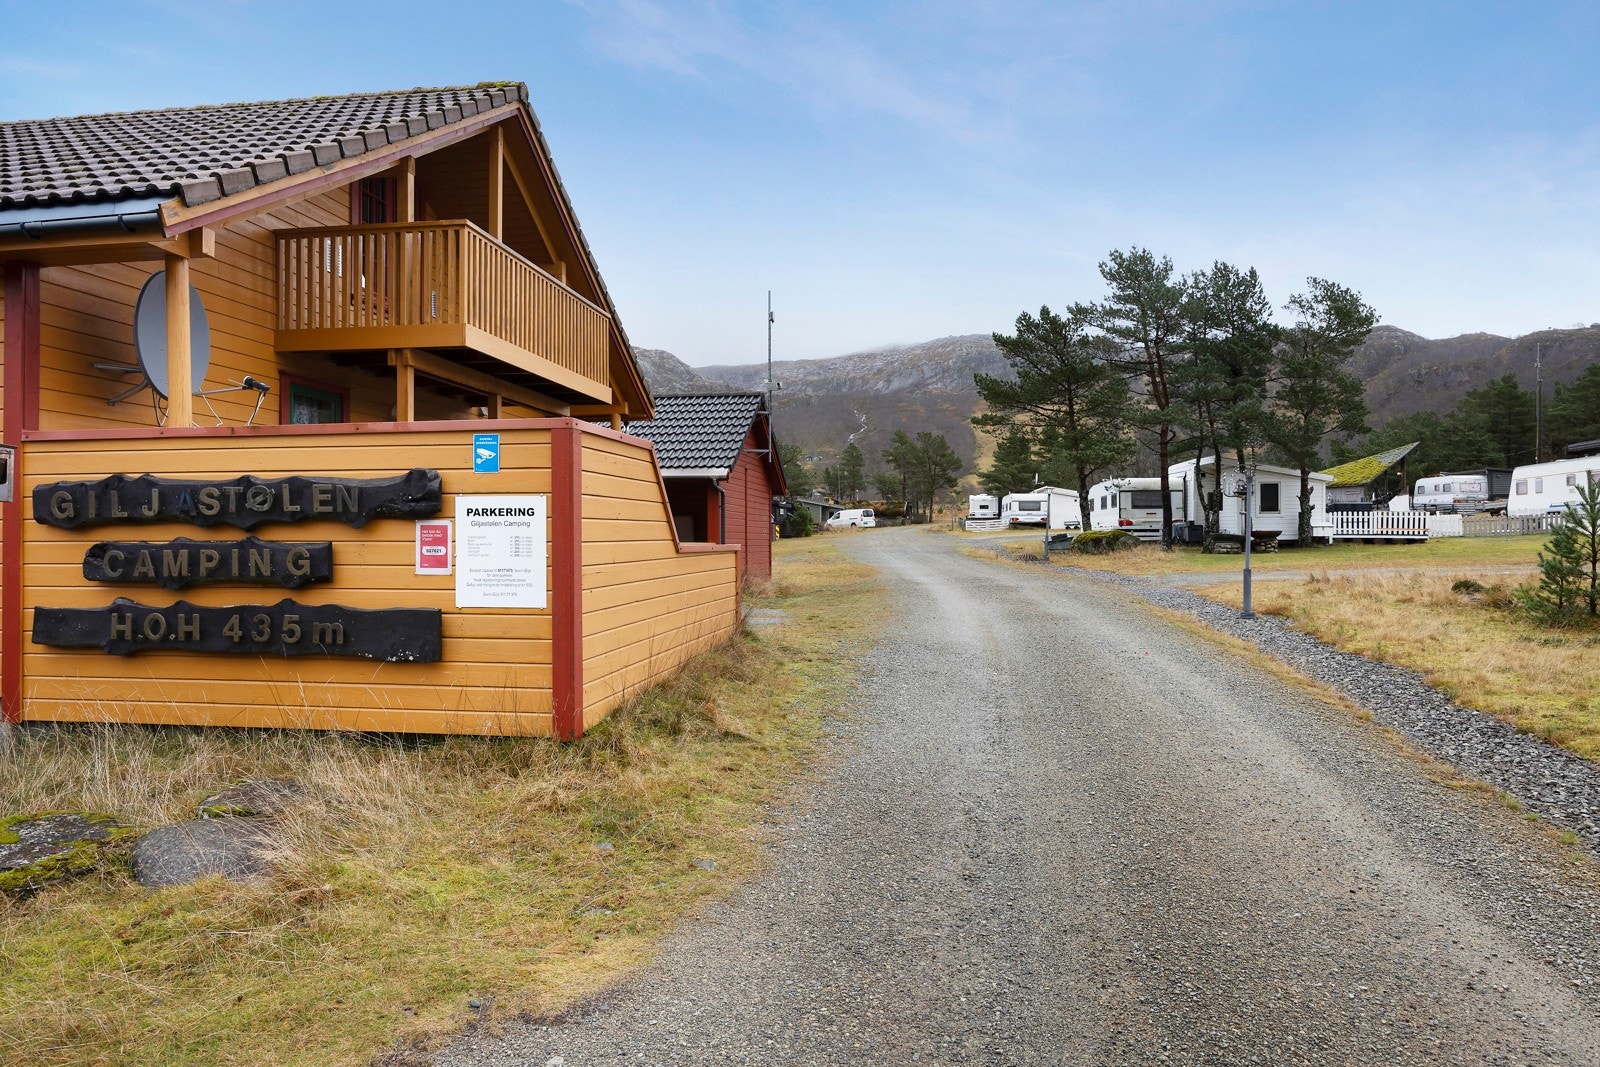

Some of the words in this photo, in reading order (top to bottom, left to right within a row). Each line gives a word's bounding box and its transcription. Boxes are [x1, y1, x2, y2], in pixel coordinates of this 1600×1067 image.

[466, 507, 535, 517] PARKERING
[503, 520, 531, 528] Camping
[102, 547, 311, 579] CAMPING
[222, 614, 301, 645] 435
[312, 620, 344, 646] m
